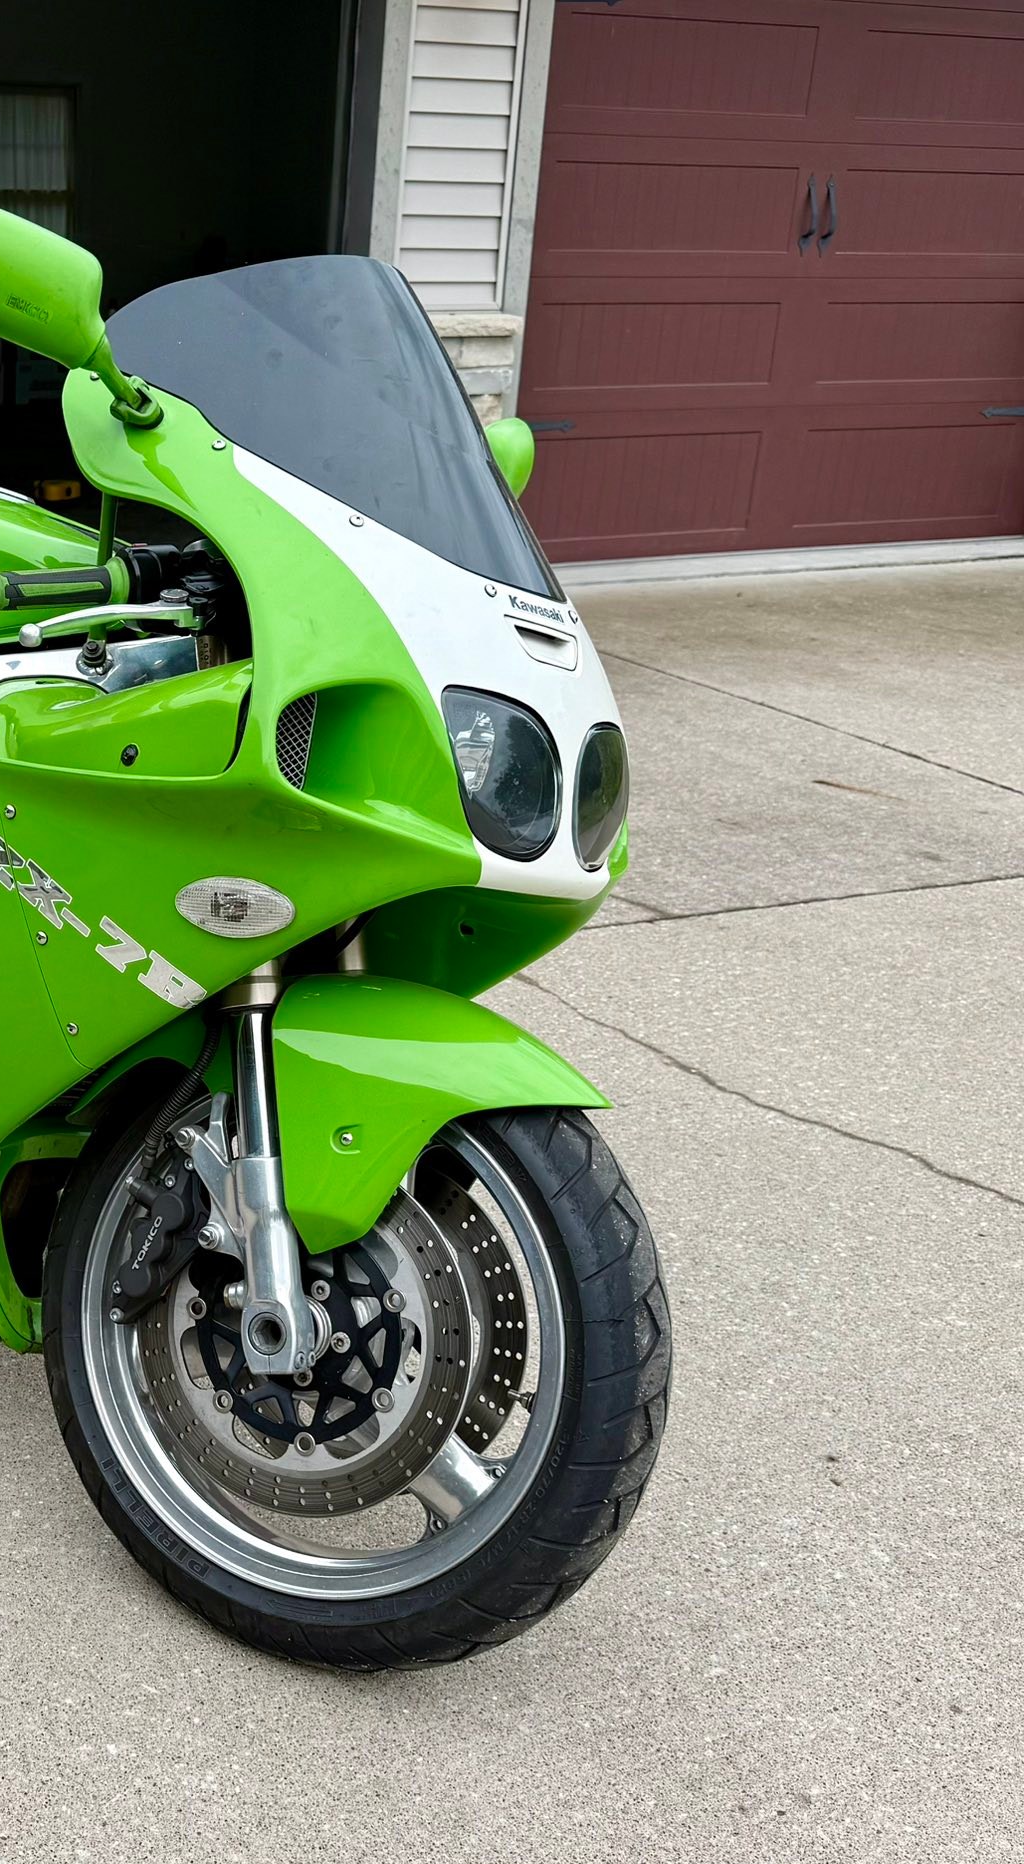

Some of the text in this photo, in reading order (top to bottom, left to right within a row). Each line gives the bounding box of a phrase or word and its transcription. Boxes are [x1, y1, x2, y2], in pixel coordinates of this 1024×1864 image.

[508, 595, 564, 623] Kawasaki
[132, 1216, 163, 1270] TOKICO
[100, 1456, 209, 1578] PIRELLI
